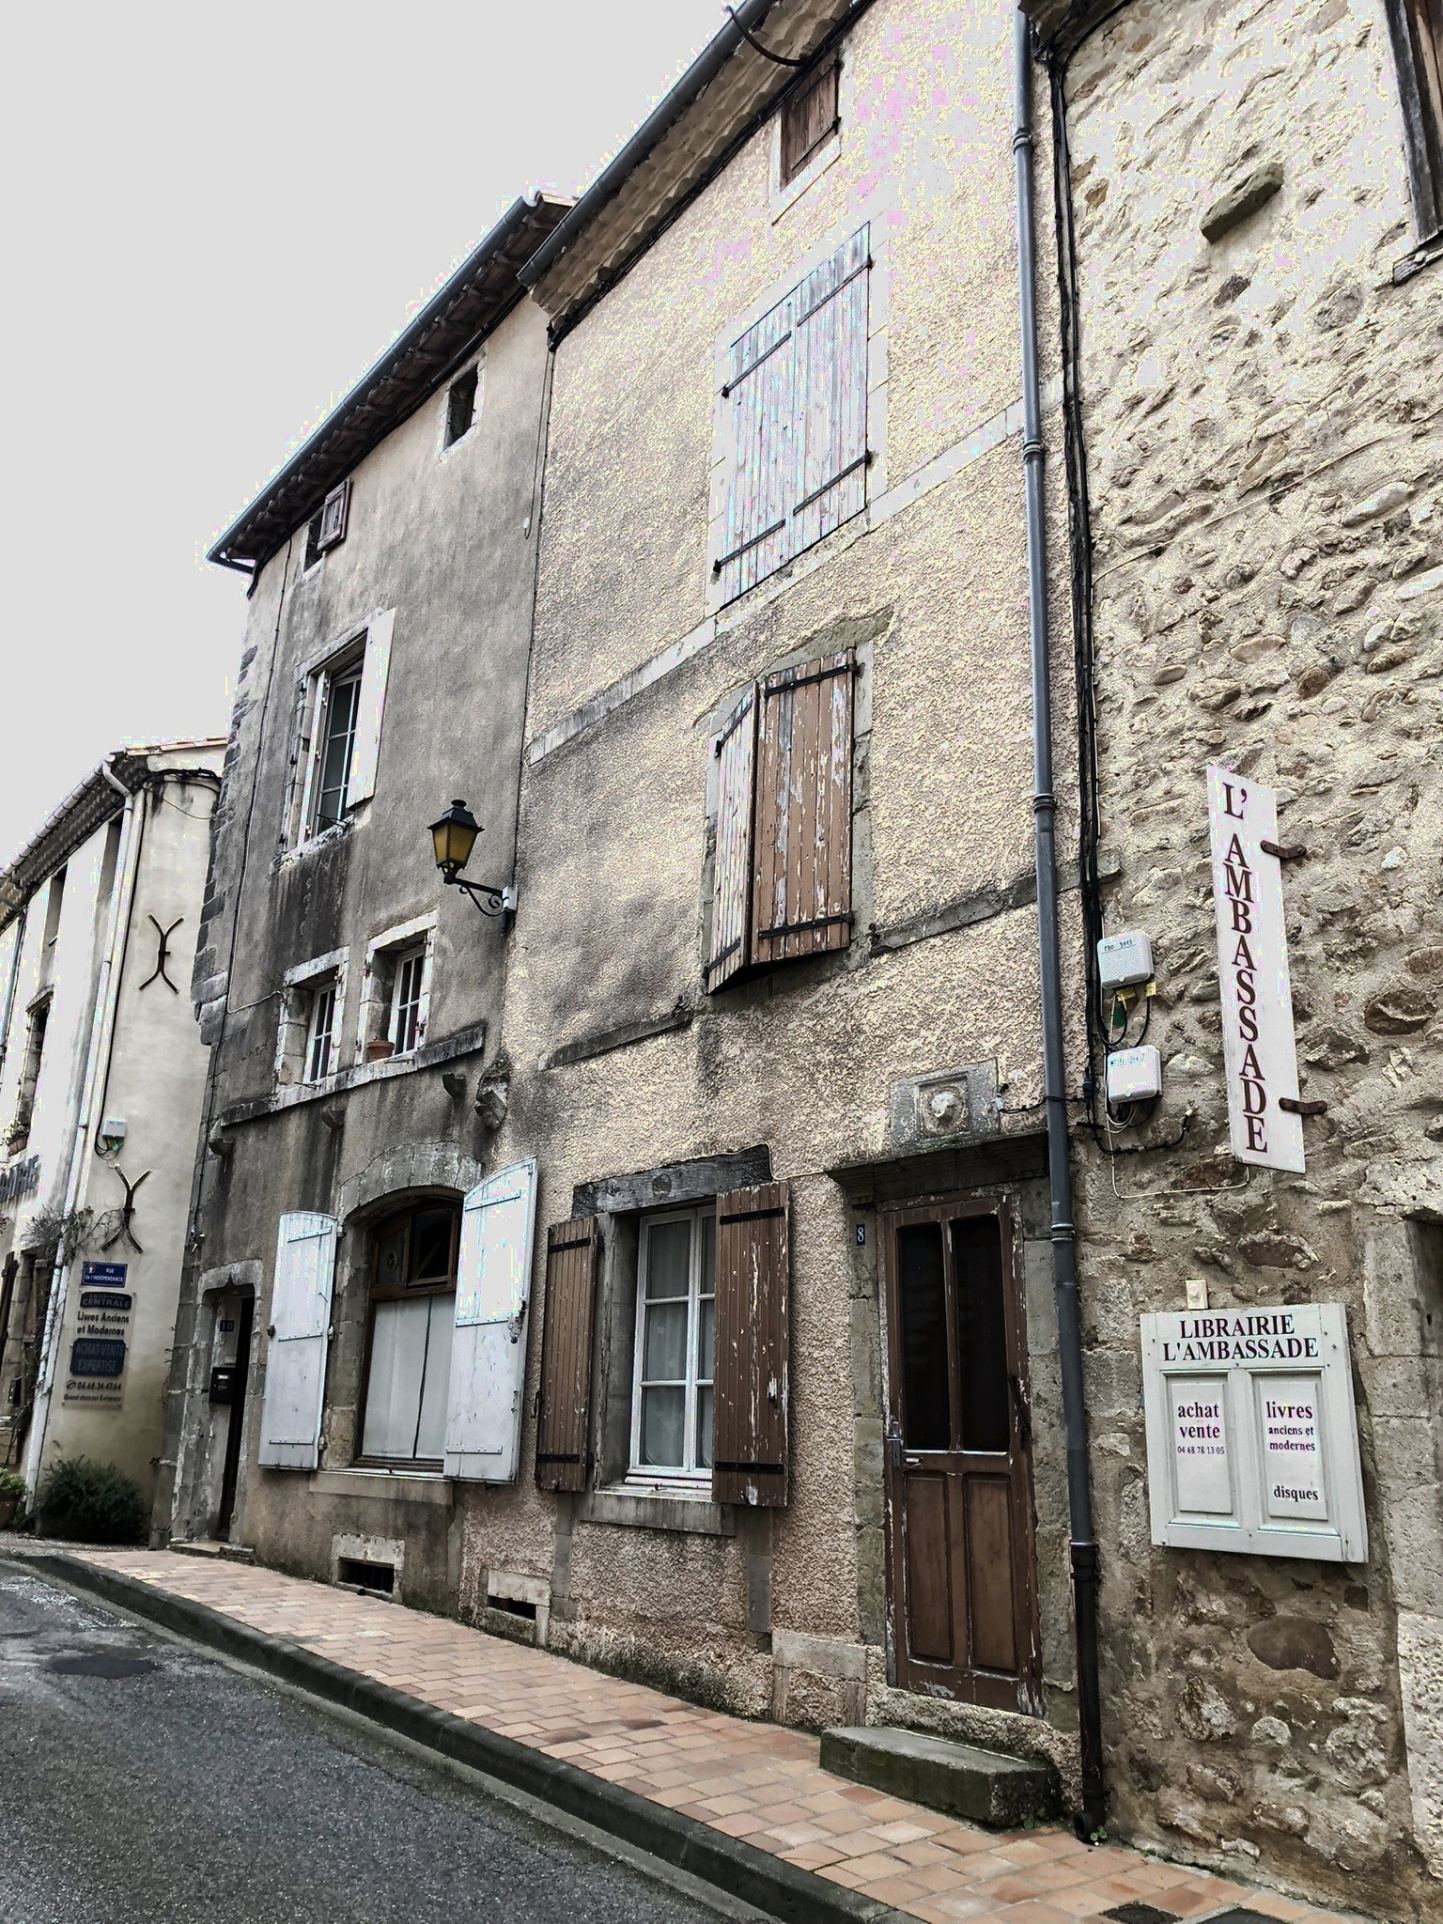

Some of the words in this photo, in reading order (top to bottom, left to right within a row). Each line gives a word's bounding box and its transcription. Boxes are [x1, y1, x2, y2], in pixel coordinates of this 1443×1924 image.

[857, 1226, 864, 1243] 8
[82, 1298, 130, 1309] CENTRALE
[77, 1311, 99, 1321] Livres
[101, 1312, 129, 1323] Anciens
[77, 1325, 85, 1334] et
[87, 1324, 125, 1336] Modernes
[221, 1321, 234, 1331] 10
[1179, 1314, 1295, 1339] LIBRAIRIE
[1162, 1337, 1319, 1361] L'AMBASSADE
[77, 1359, 117, 1373] EXPERTISE
[1177, 1401, 1220, 1418] achat
[1266, 1401, 1313, 1419] livres
[1179, 1424, 1221, 1439] vente
[1268, 1425, 1303, 1436] anciens
[1305, 1426, 1314, 1437] et
[1177, 1445, 1186, 1454] 04
[1187, 1446, 1195, 1454] 68
[1197, 1446, 1206, 1454] 78
[1207, 1446, 1215, 1455] 13
[1269, 1440, 1316, 1452] modernes
[1273, 1485, 1319, 1502] disques
